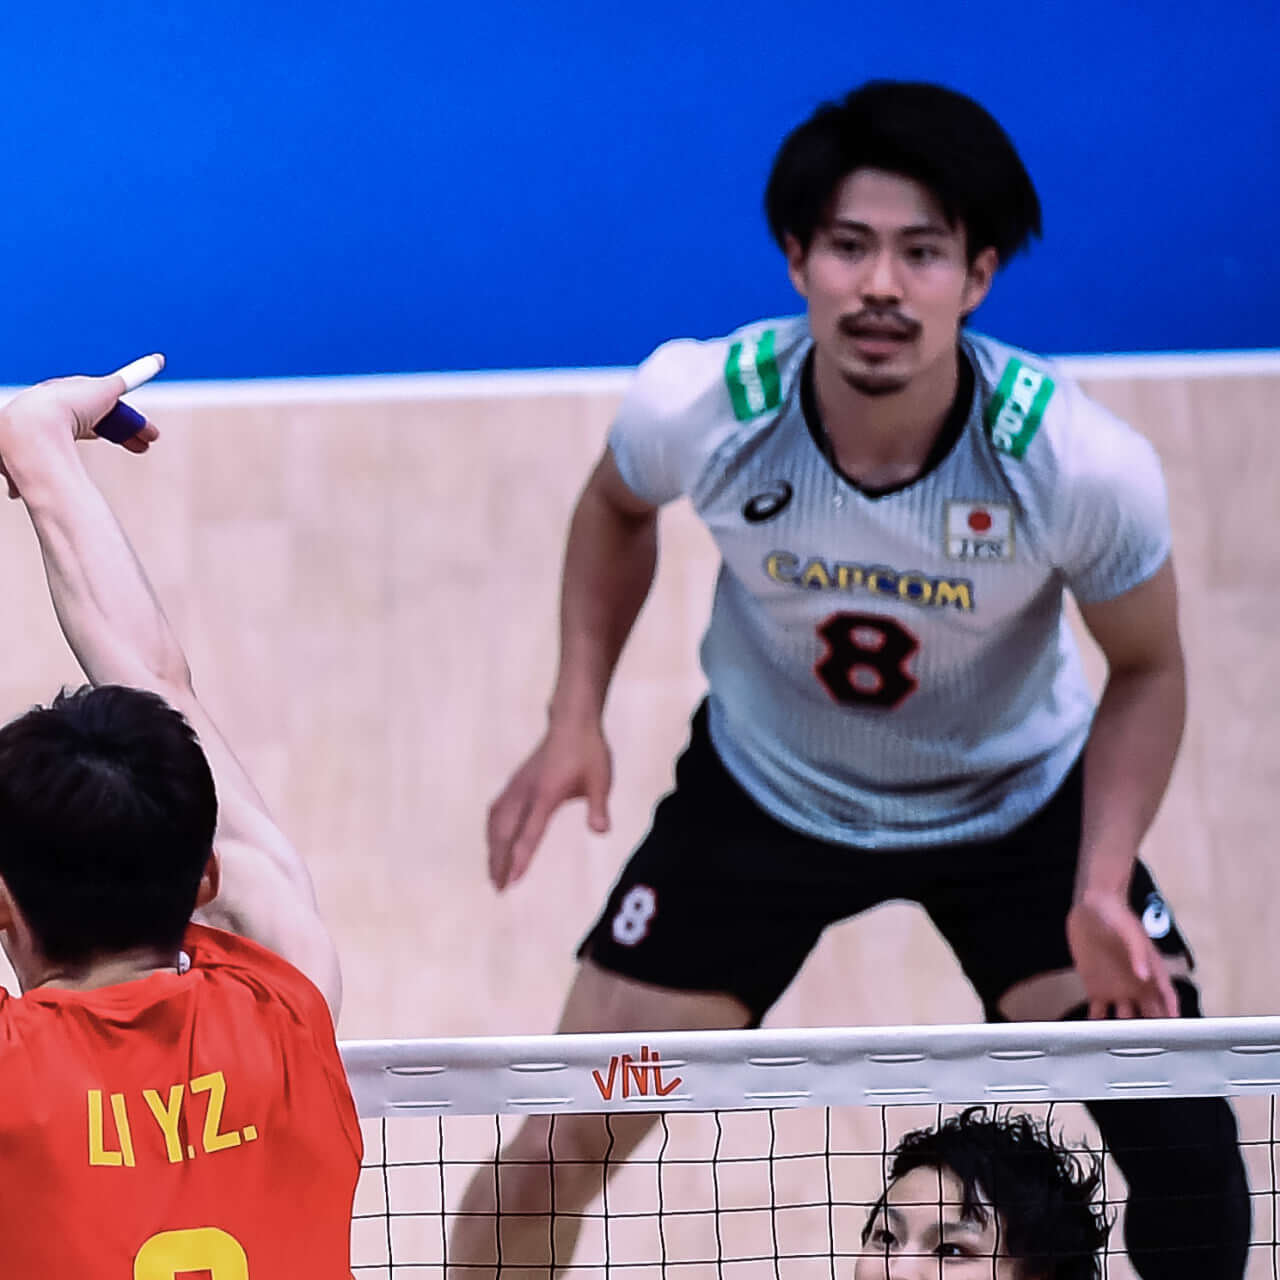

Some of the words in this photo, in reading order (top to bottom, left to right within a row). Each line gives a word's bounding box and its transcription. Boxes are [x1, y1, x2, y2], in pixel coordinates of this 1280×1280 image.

[762, 550, 975, 613] CAPCOM
[814, 610, 921, 711] 8
[612, 883, 659, 946] 8
[87, 1089, 136, 1168] LI
[142, 1071, 258, 1164] Y.Z.
